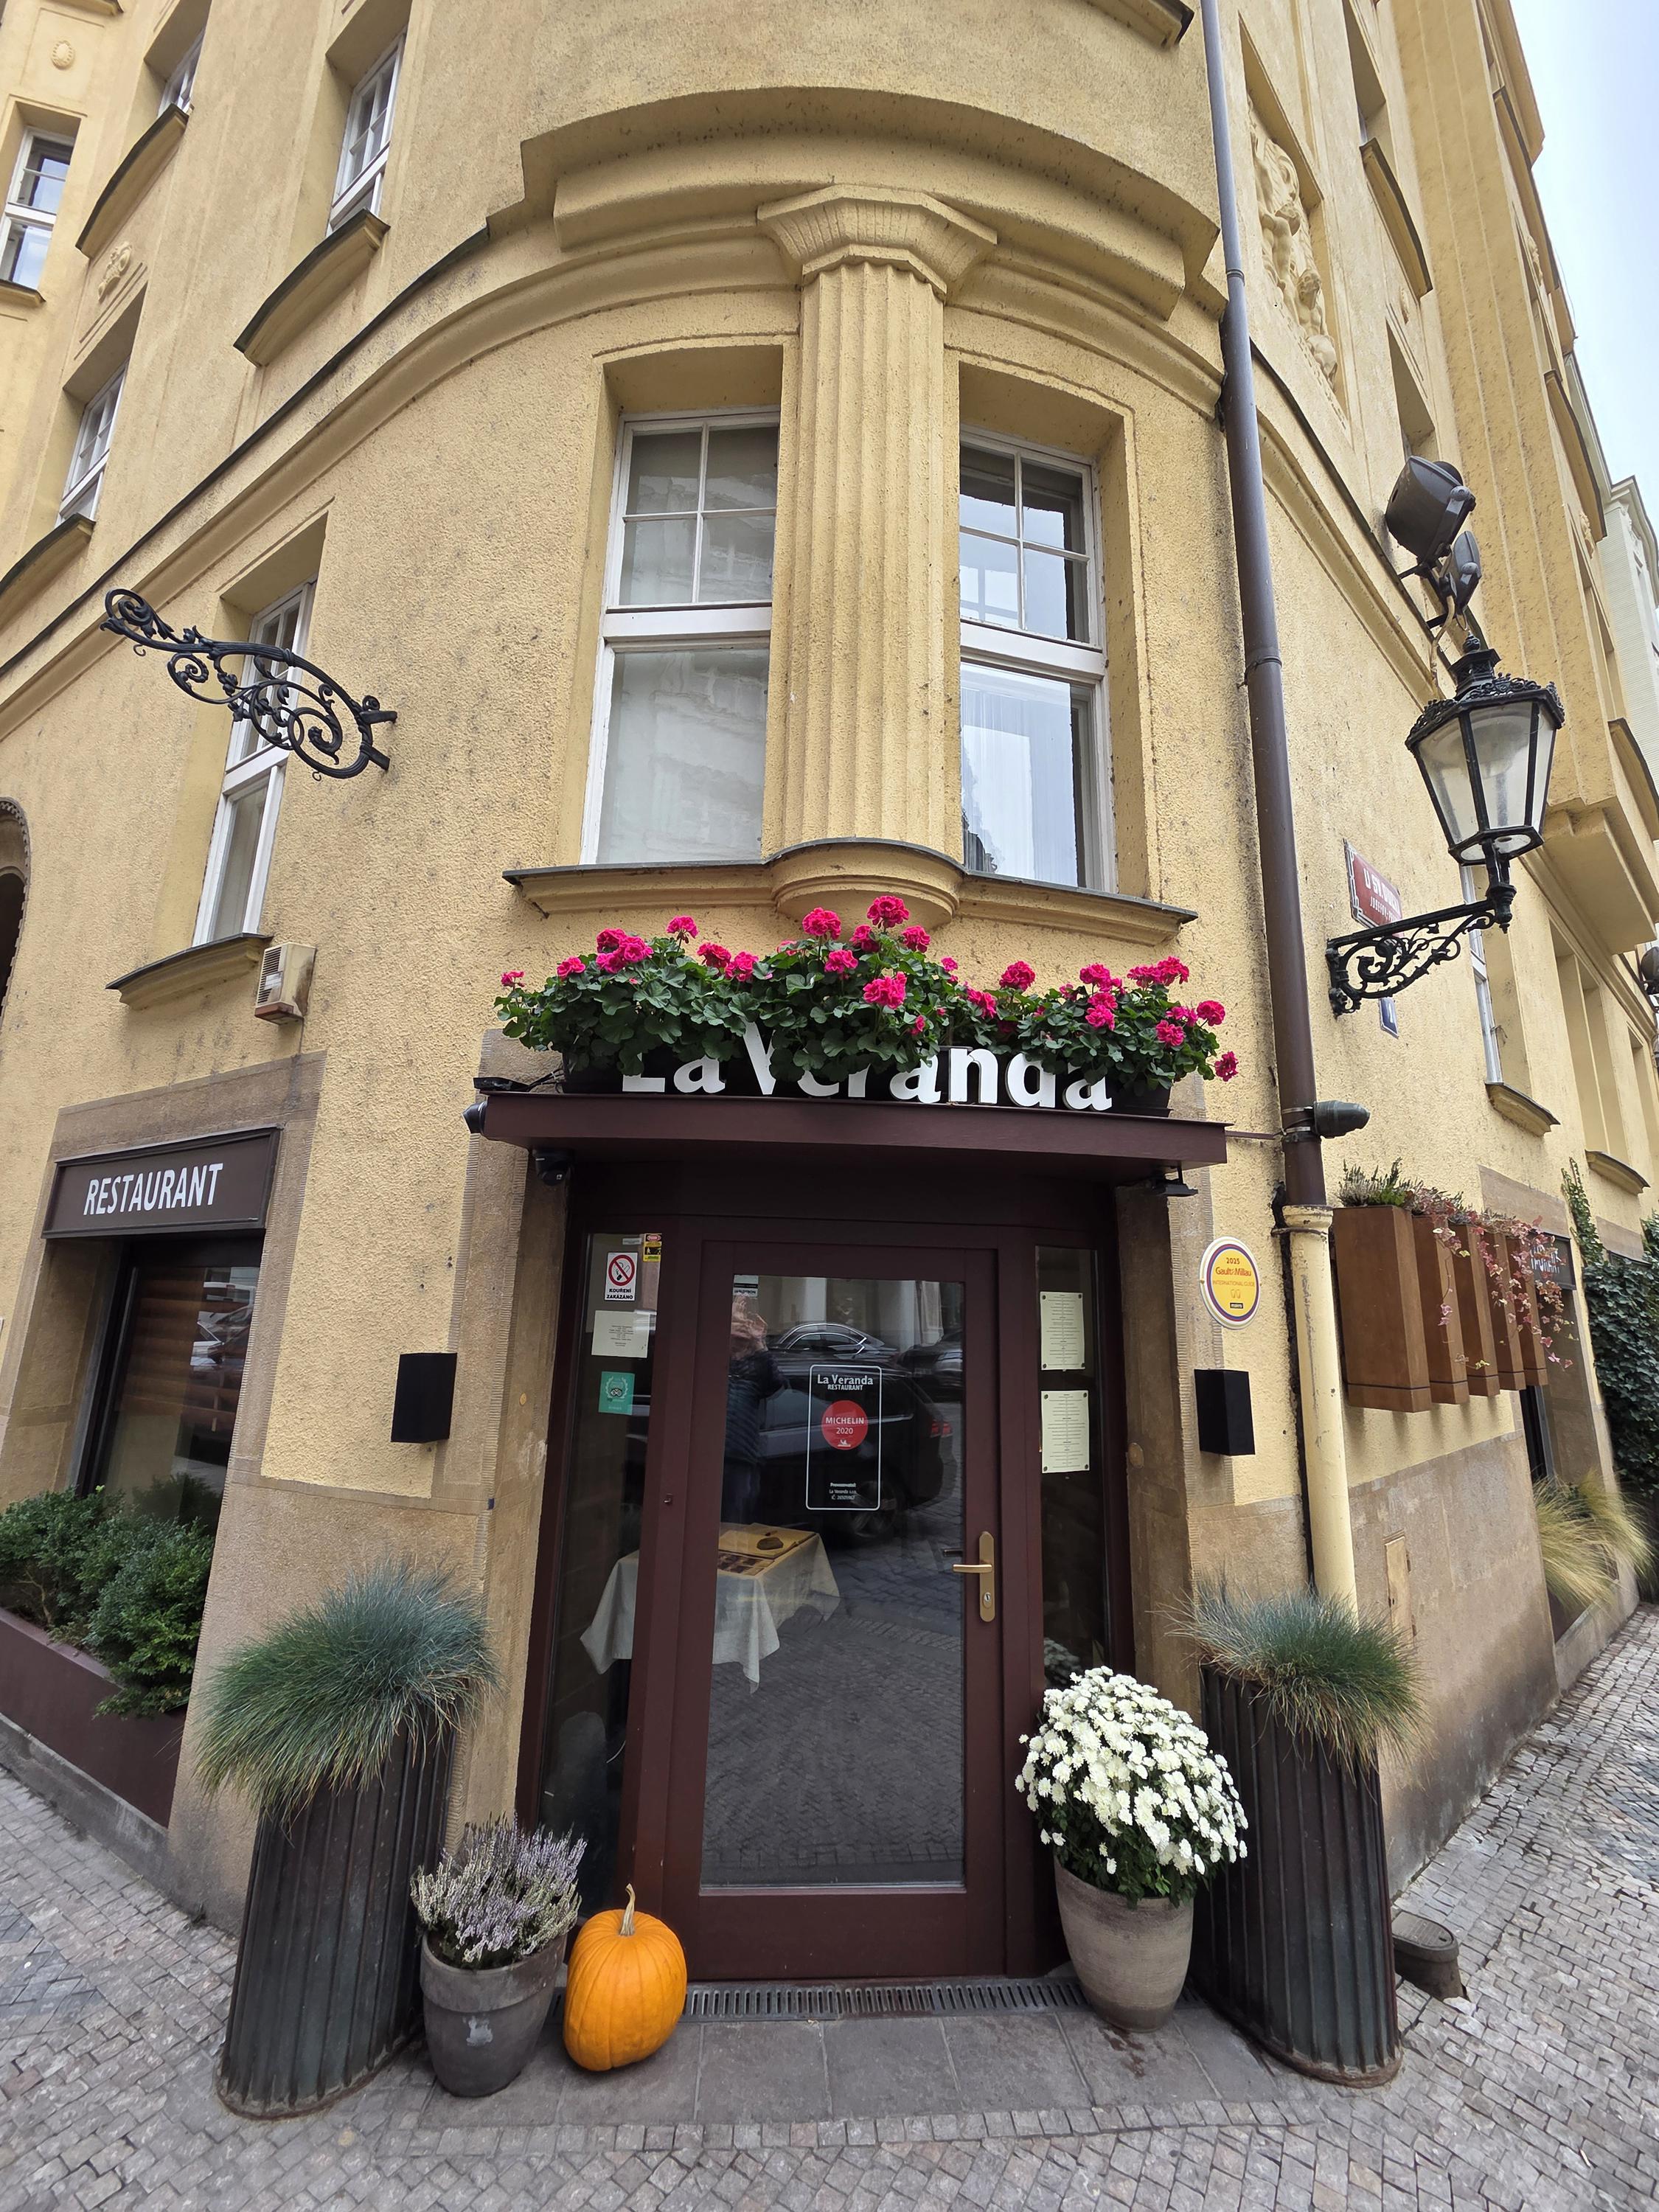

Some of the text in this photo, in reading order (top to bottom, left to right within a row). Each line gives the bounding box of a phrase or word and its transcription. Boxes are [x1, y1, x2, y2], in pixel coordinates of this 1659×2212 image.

[1363, 867, 1371, 889] U
[83, 1162, 224, 1216] RESTAURANT
[817, 1374, 874, 1385] La Veranda
[825, 1416, 864, 1425] MICHELIN
[836, 1427, 854, 1435] 2020
